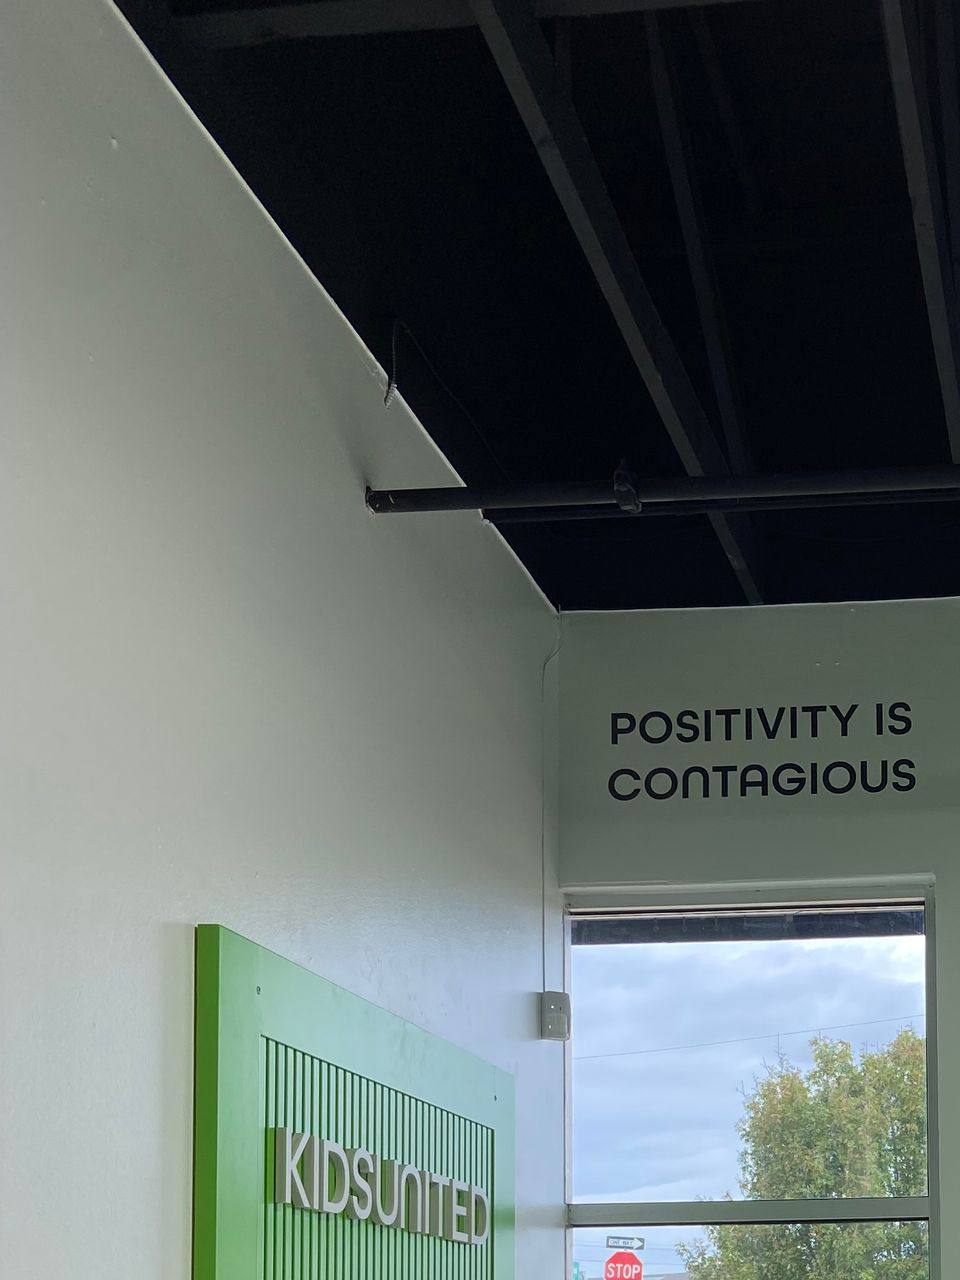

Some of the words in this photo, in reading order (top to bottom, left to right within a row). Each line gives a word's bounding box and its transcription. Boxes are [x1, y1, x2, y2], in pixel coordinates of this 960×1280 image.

[610, 703, 859, 745] POSITIVITY
[875, 701, 913, 736] IS
[608, 758, 917, 802] CONTAGIOUS
[275, 1125, 490, 1246] KIDSUNITED
[606, 1263, 641, 1280] STOP
